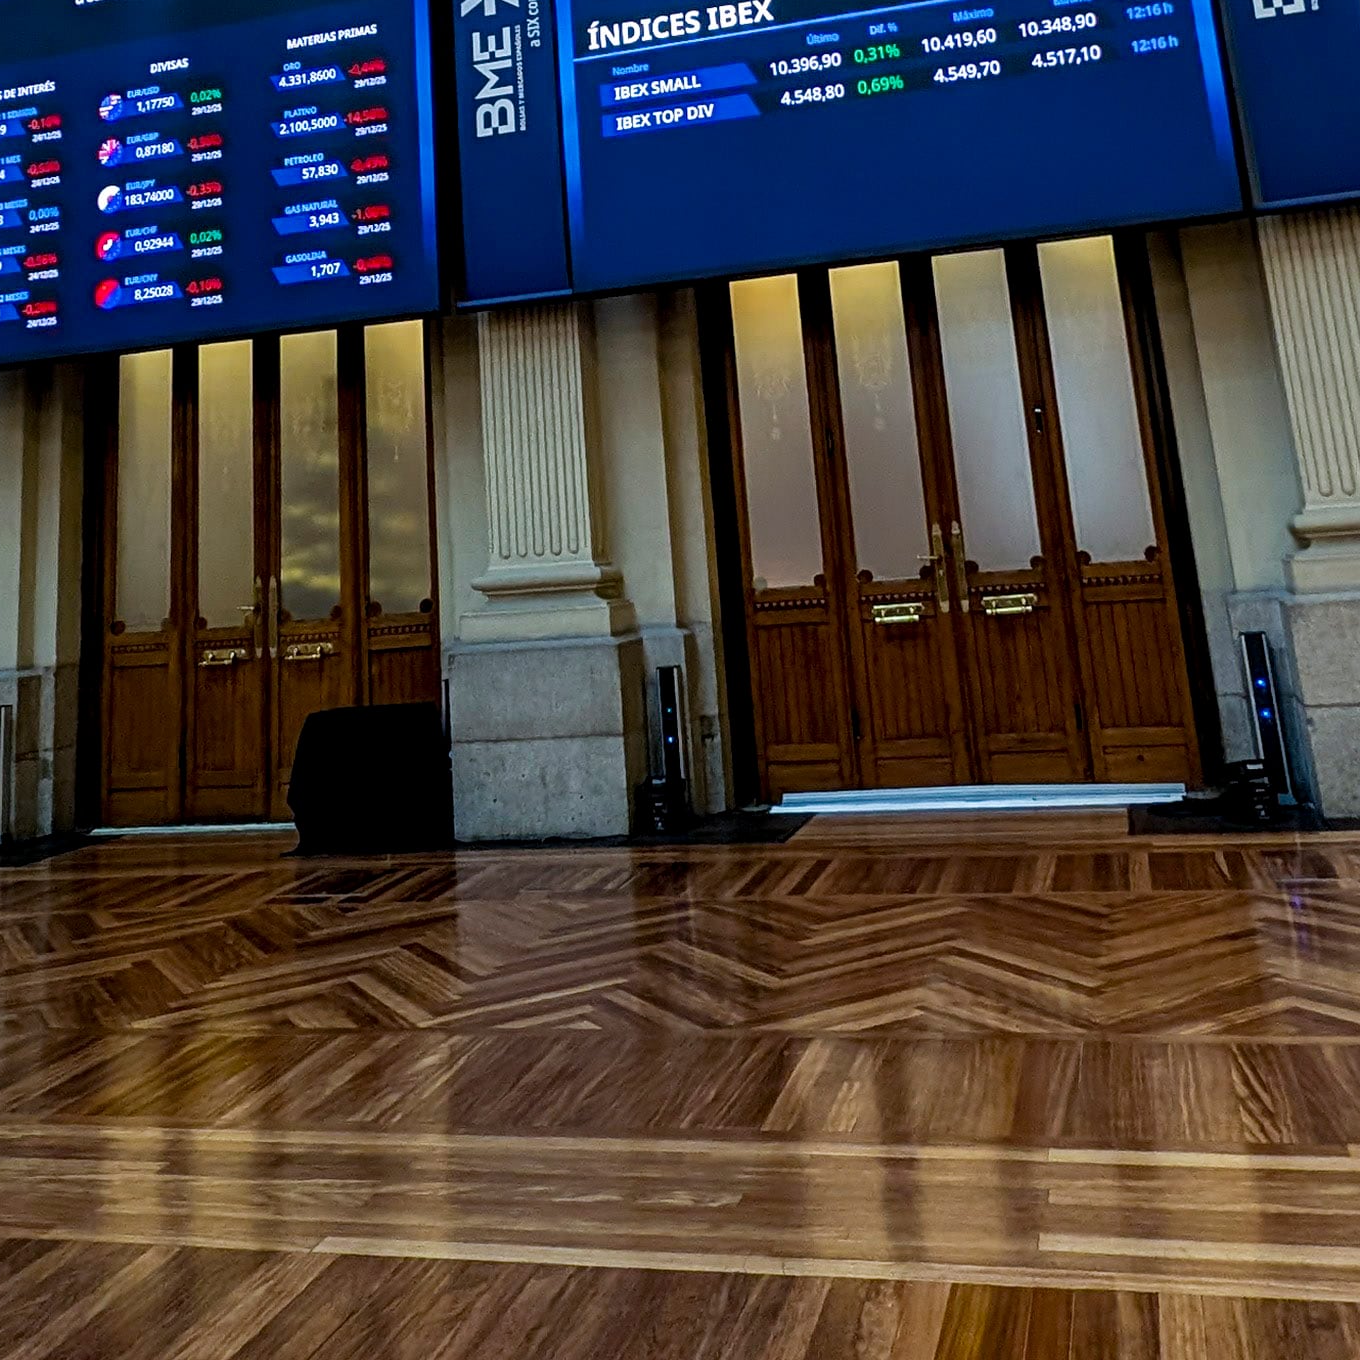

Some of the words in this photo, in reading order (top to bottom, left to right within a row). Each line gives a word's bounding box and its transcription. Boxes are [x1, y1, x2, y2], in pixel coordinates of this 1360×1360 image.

[287, 30, 337, 50] MATERIAS
[338, 24, 377, 42] PRIMAS
[527, 17, 541, 38] SIX
[587, 9, 701, 50] ÍNDICES
[612, 62, 649, 76] Nombre
[806, 32, 840, 46] Último
[953, 6, 994, 23] Máximo
[614, 81, 649, 101] IBEX
[651, 75, 701, 95] SMALL
[769, 52, 842, 77] 10.396,90
[854, 43, 900, 66] 0,31%
[921, 28, 997, 54] 10.419,60
[1018, 12, 1097, 39] 10.348,90
[1126, 4, 1161, 21] 12:16
[150, 57, 189, 75] DIVISAS
[279, 68, 336, 87] 4.331,8600
[472, 26, 516, 138] BME
[616, 112, 652, 131] IBEX
[655, 108, 685, 126] TOP
[687, 103, 714, 120] DIV
[780, 83, 845, 106] 4.548,80
[857, 75, 904, 97] 0,69%
[933, 59, 1001, 85] 4.549,70
[1032, 44, 1101, 70] 4.517,10
[1131, 38, 1166, 54] 12:16
[4, 88, 17, 99] DE
[18, 80, 56, 97] INTERÉS
[137, 96, 175, 113] 1,17750
[279, 116, 337, 135] 2.100,5000
[136, 142, 174, 158] 0,87180
[302, 164, 338, 180] 57,830
[124, 189, 174, 206] 183,74000
[309, 212, 339, 228] 3,943
[311, 262, 340, 277] 1,707
[134, 285, 173, 300] 8,25028
